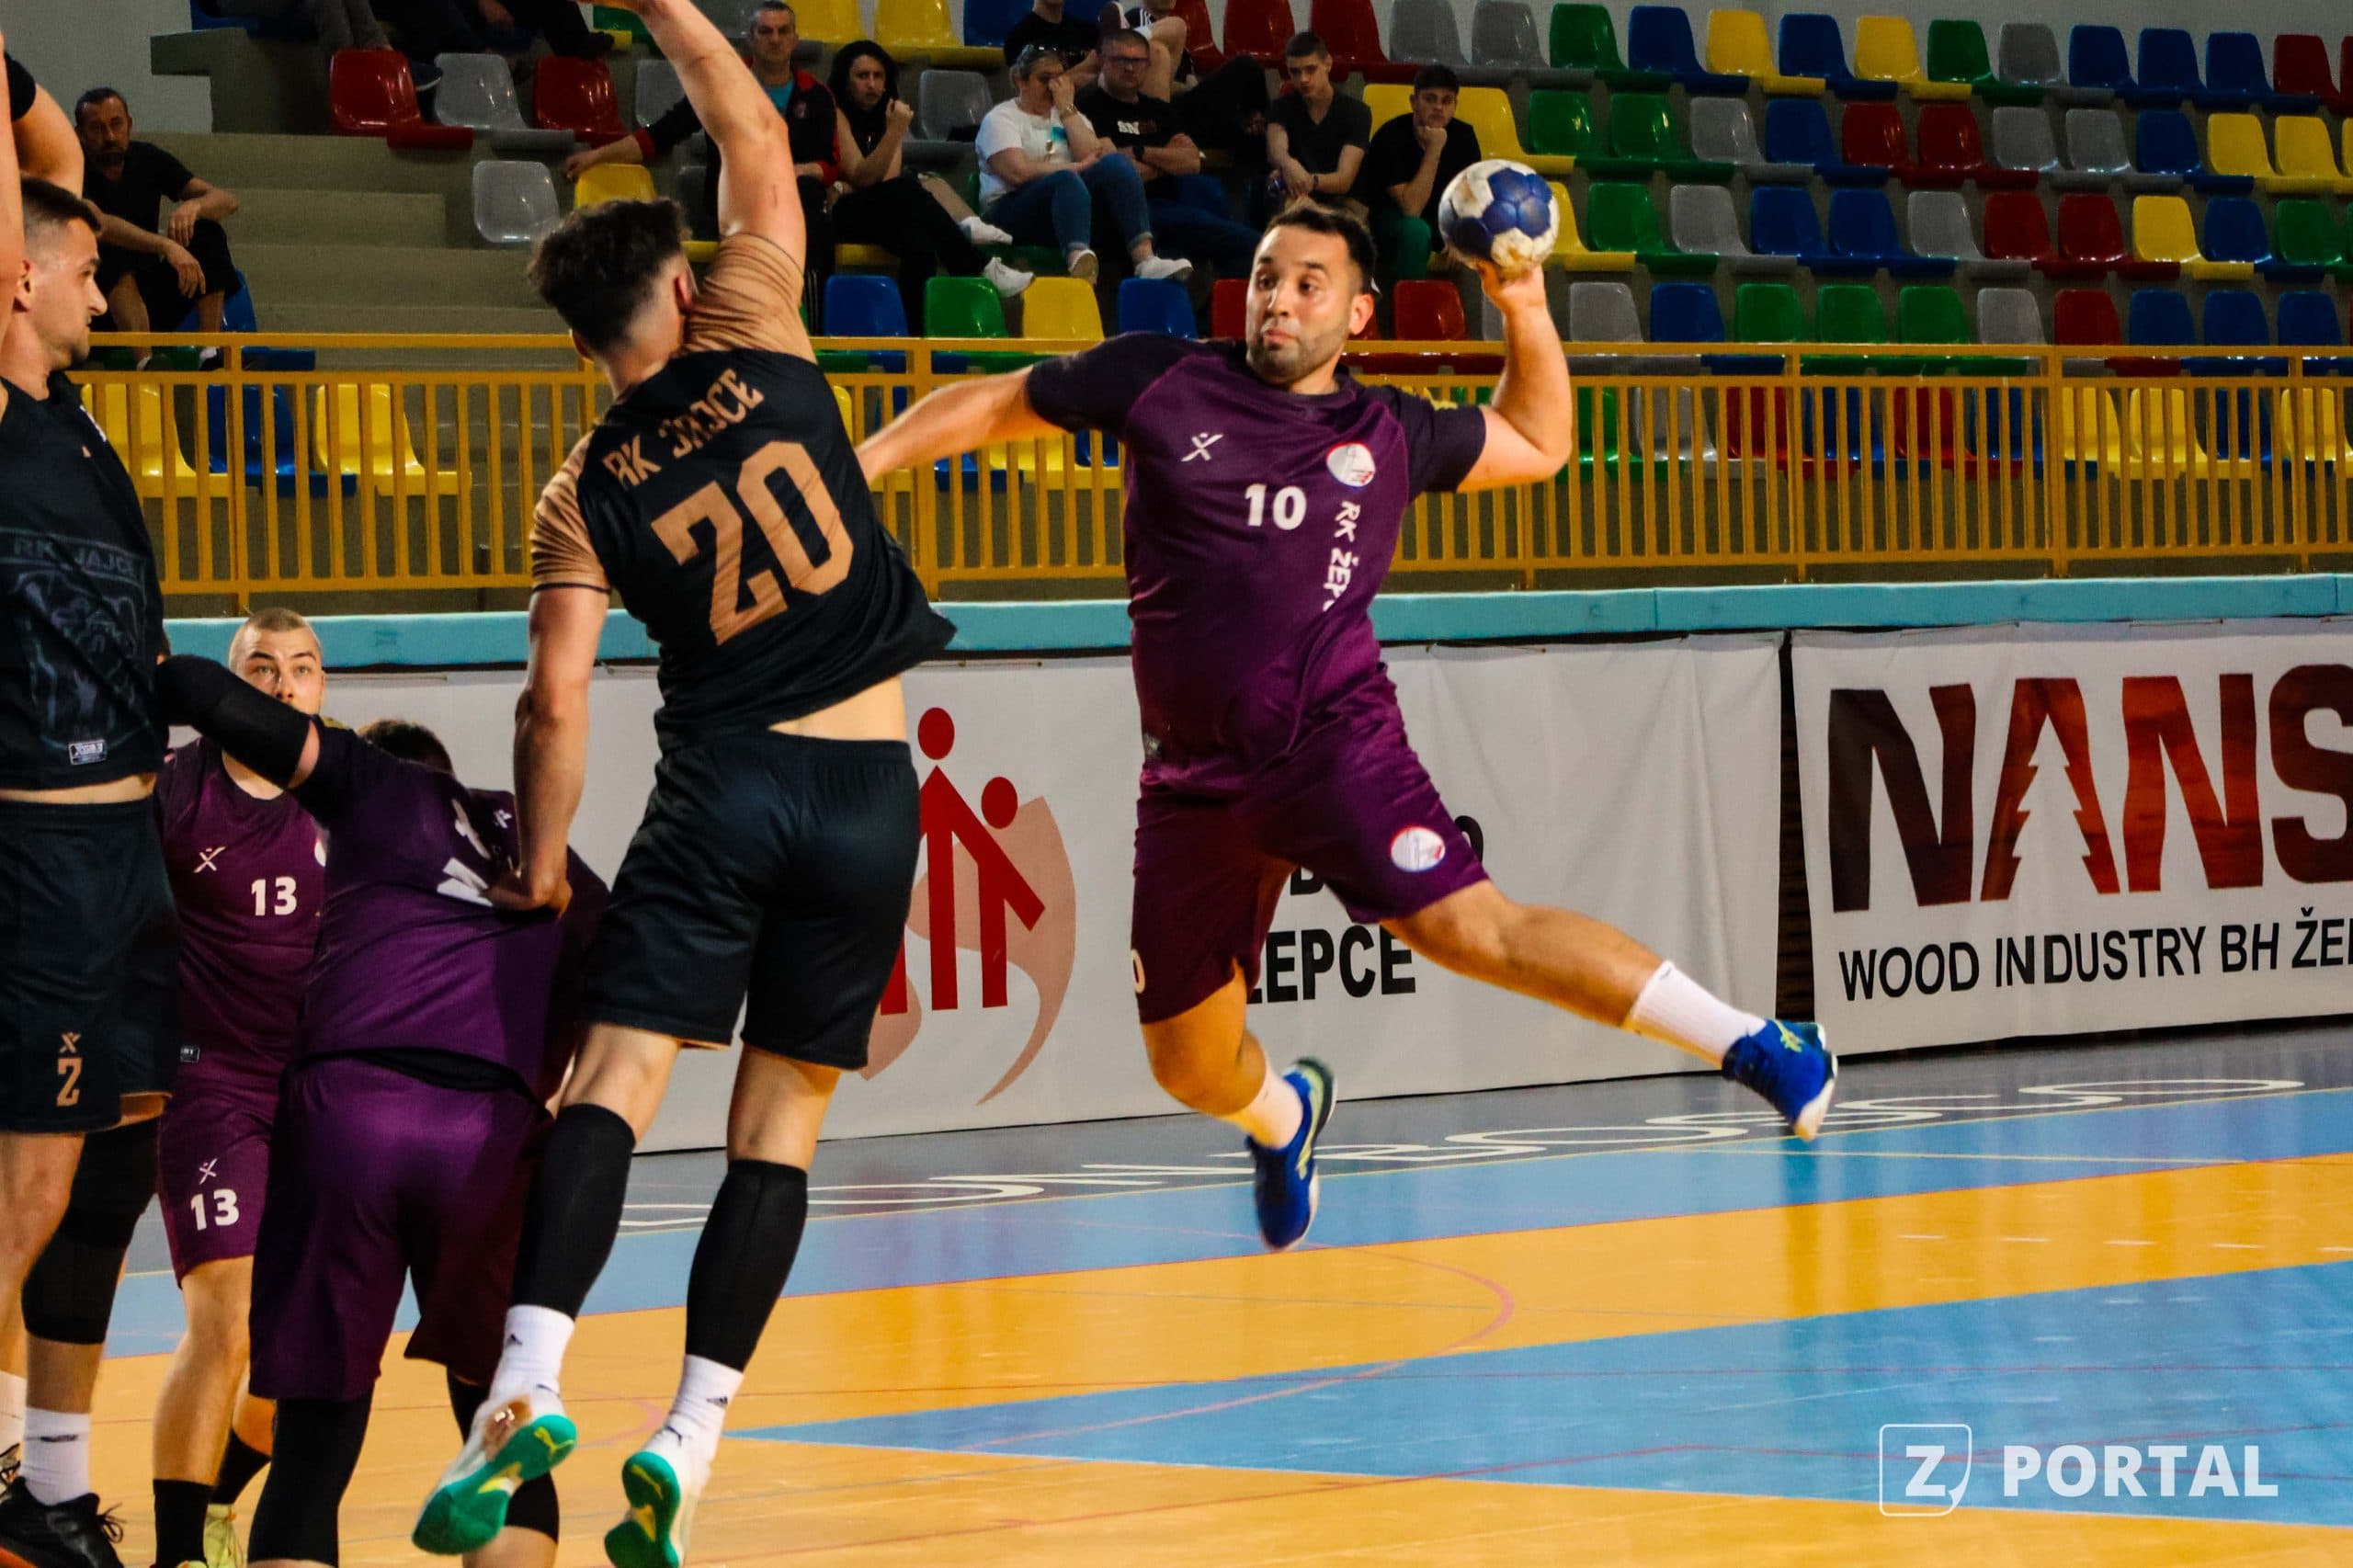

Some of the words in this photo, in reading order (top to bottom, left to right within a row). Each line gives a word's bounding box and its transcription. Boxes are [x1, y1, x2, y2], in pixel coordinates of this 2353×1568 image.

[602, 434, 662, 491] RK
[1245, 483, 1307, 530] 10
[1335, 501, 1361, 542] RK
[650, 440, 855, 646] 20
[250, 876, 298, 916] 13
[1838, 940, 1980, 1002] WOOD
[1995, 926, 2207, 987] INDUSTRY
[2220, 922, 2280, 973] BH
[2291, 906, 2353, 969] ŽE
[56, 1057, 83, 1107] 2
[190, 1187, 240, 1232] 13
